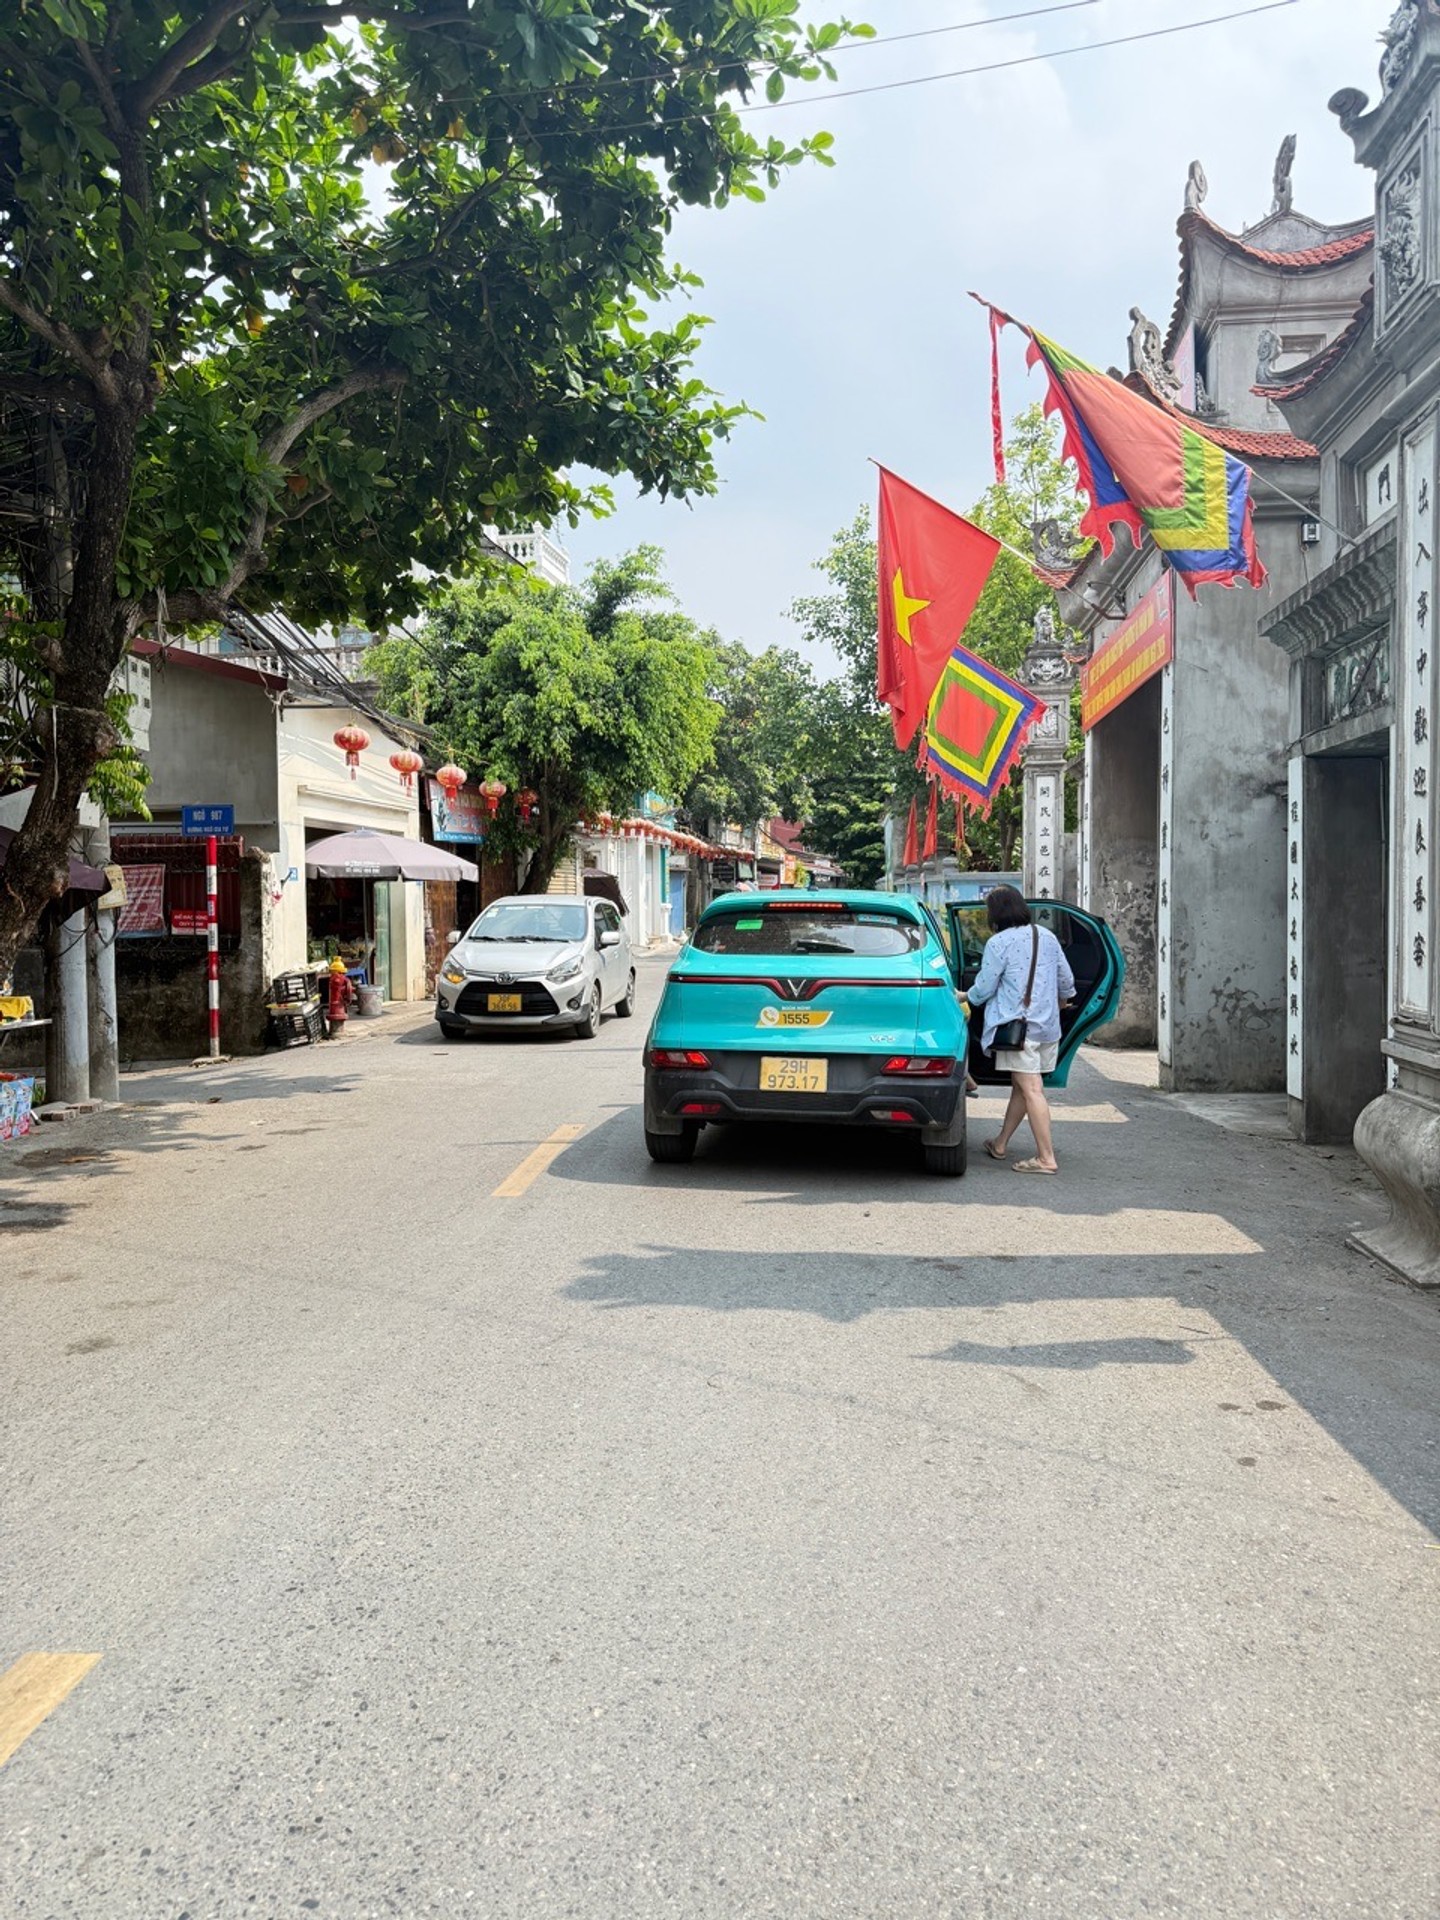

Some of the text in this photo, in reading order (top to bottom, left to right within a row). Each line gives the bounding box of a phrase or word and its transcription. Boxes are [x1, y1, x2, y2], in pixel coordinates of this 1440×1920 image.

[782, 1013, 810, 1025] 1555
[780, 1060, 808, 1073] 29H
[767, 1075, 818, 1090] 973.17
